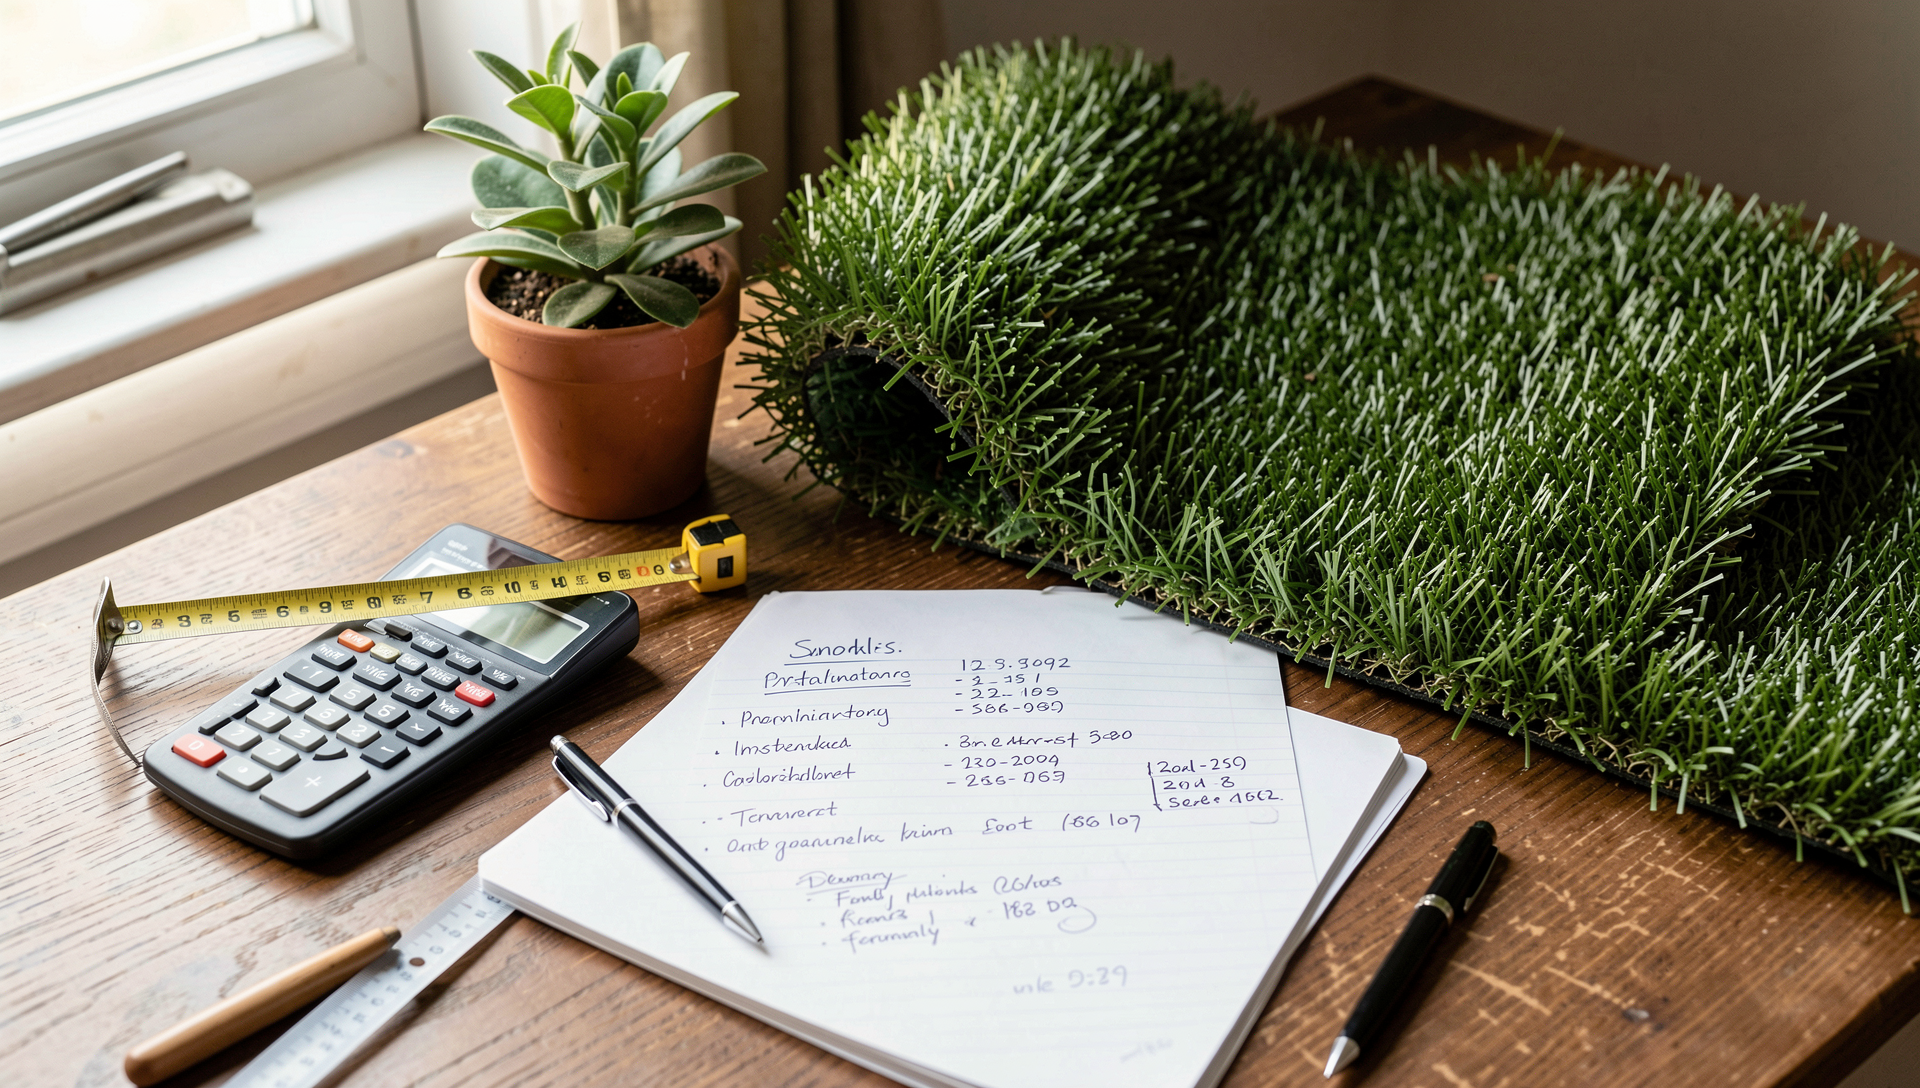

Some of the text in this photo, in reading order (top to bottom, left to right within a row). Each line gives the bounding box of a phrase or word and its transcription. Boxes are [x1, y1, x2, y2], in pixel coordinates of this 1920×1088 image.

[228, 610, 240, 622] 5
[276, 605, 289, 618] 6
[319, 601, 332, 613] 9
[420, 591, 433, 604] 7
[343, 689, 361, 700] 5
